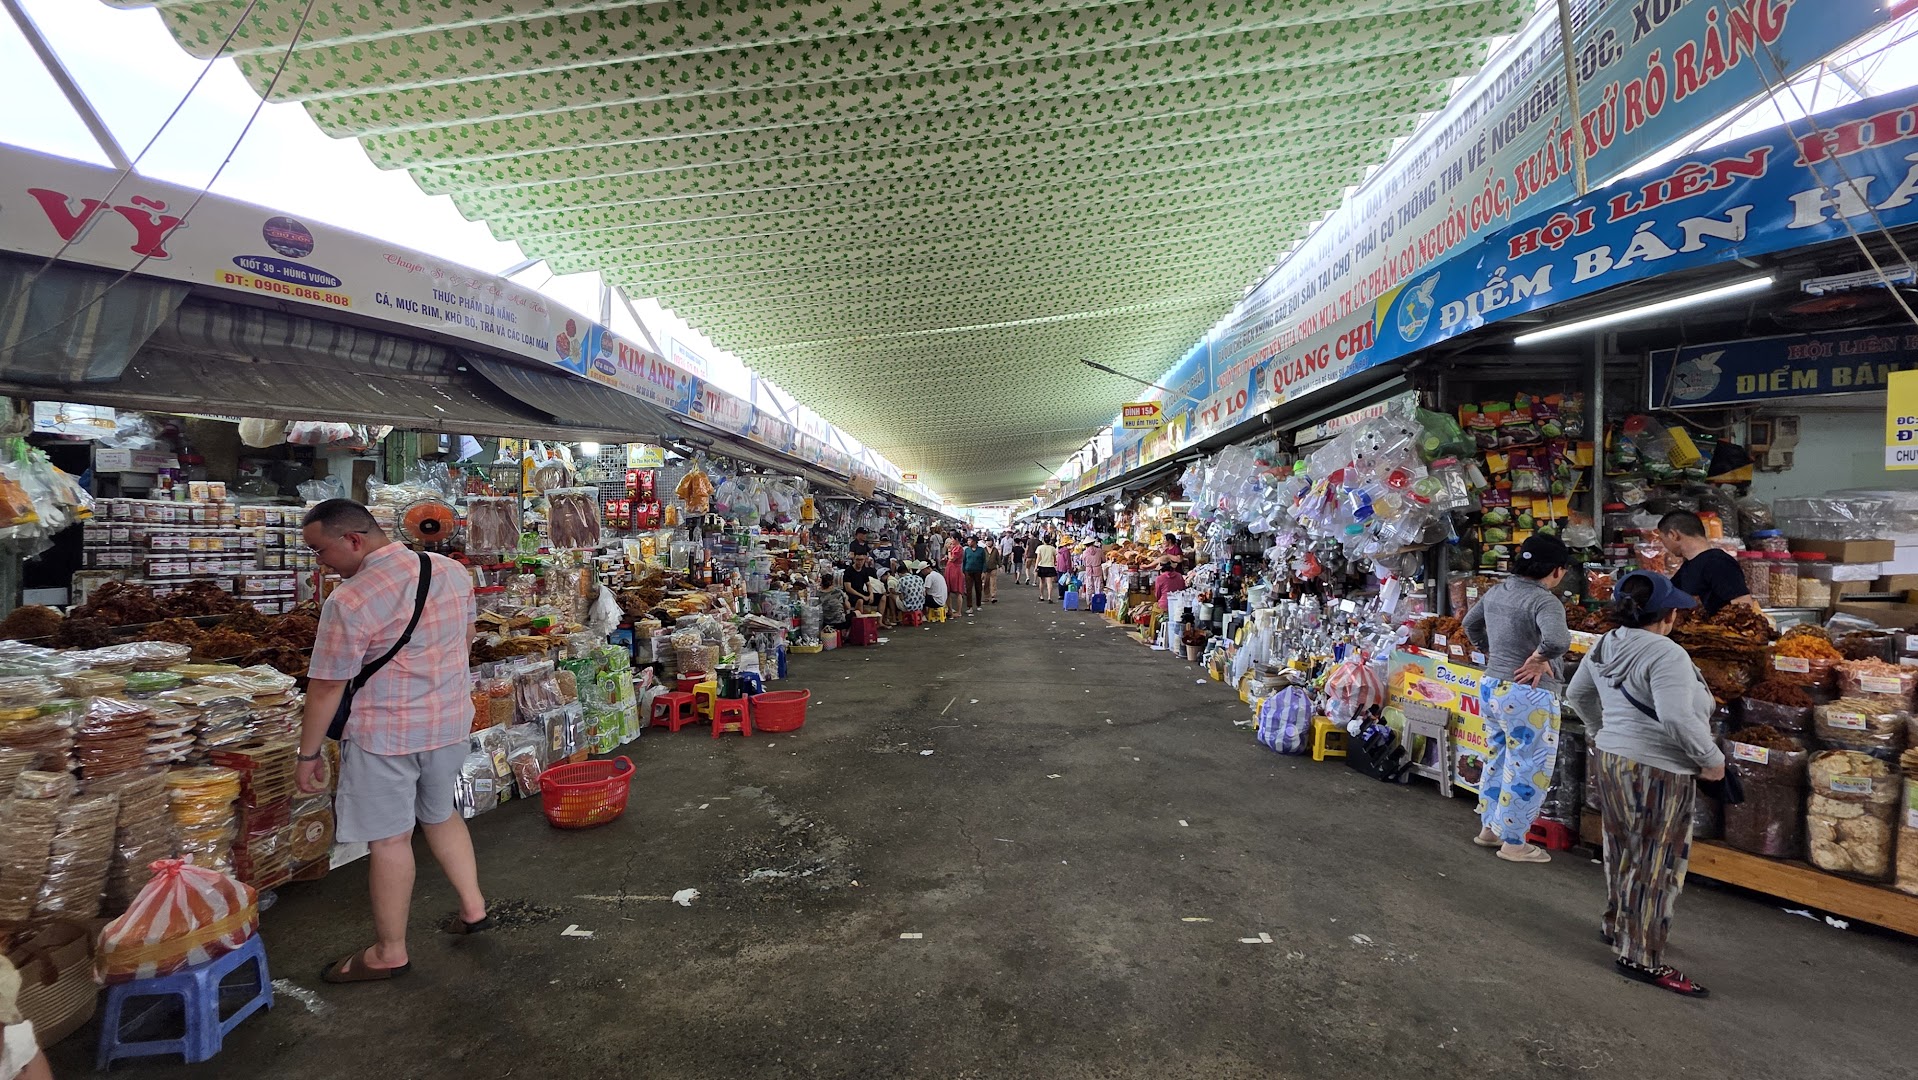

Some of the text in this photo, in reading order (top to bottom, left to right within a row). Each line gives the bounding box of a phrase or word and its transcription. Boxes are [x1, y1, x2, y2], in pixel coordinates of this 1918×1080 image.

[1318, 266, 1332, 294] TẠI
[1332, 253, 1351, 282] CHỢ
[1356, 229, 1377, 263] PHẢI
[1379, 211, 1395, 244] CÓ
[1397, 178, 1437, 231] THÔNG
[1440, 156, 1463, 195] TIN
[1467, 128, 1487, 174] VỀ
[1491, 79, 1560, 156] NGUỒN
[1369, 244, 1399, 301] PHẨM
[1399, 235, 1416, 280] CÓ
[1418, 197, 1468, 269] NGUỒN
[1471, 167, 1511, 232] GỐC,
[1513, 116, 1574, 206] XUẤT
[1580, 80, 1620, 161] XỨ
[1623, 47, 1668, 135] RÕ
[1506, 206, 1597, 261] HỘI
[1607, 145, 1774, 225] LIÊN
[240, 257, 261, 270] KIỐT
[263, 263, 275, 273] 39
[283, 266, 307, 280] HÙNG
[309, 272, 337, 287] VƯƠNG
[1439, 264, 1554, 331] ĐIỂM
[1570, 203, 1755, 286] BÁN
[224, 273, 350, 307] ĐT: 0905.086.808
[432, 288, 517, 324] THỰC PHẨM ĐÀ NẴNG:
[375, 291, 393, 309] CÁ,
[395, 296, 419, 314] MỰC
[421, 303, 443, 321] RIM,
[445, 309, 462, 325] KHÔ
[464, 314, 478, 331] BÒ,
[480, 319, 495, 334] TRÀ
[496, 323, 506, 337] VÀ
[507, 327, 520, 342] CÁC
[521, 333, 535, 348] LOẠI
[1273, 320, 1375, 395] QUANG CHI
[1787, 341, 1833, 360] HỘI
[1837, 336, 1899, 357] LIÊN
[617, 342, 646, 378] KIM
[648, 358, 676, 392] ANH
[1736, 362, 1899, 394] ĐIỂM BÁN
[1124, 406, 1154, 416] ĐÌNH 15A
[1146, 418, 1159, 426] THỰC
[1201, 400, 1221, 426] TÝ
[1226, 388, 1248, 416] LO
[1437, 665, 1476, 688] Đặc sản
[1467, 729, 1481, 746] ĐẶC
